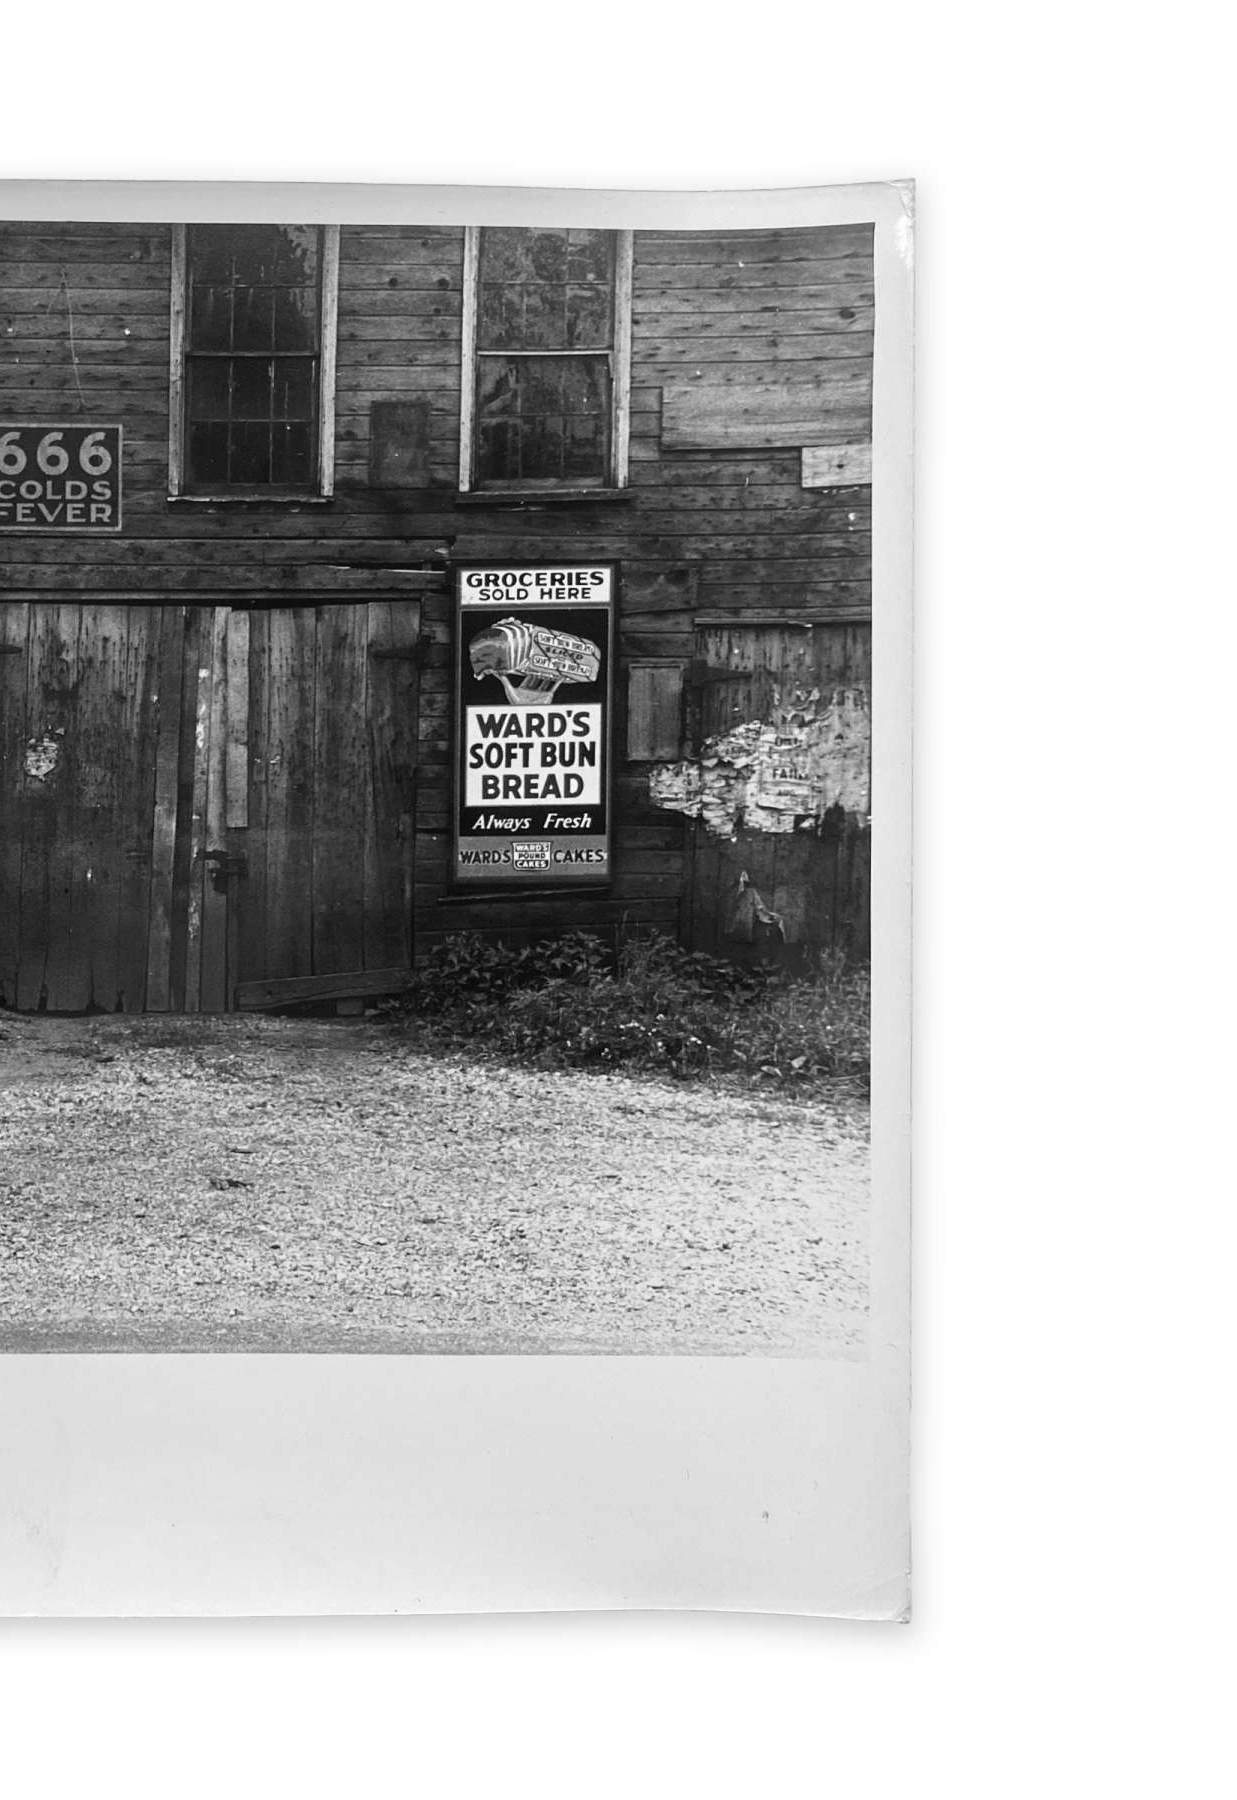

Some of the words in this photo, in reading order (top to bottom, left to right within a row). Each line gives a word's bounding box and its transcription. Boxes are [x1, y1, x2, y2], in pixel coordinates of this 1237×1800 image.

[466, 571, 604, 588] GROCERIES
[479, 588, 529, 601] SOLD
[540, 587, 592, 600] HERE
[476, 710, 590, 738] WARD'S
[469, 742, 534, 769] SOFT
[540, 741, 596, 768] BUN
[481, 773, 584, 800] BREAD
[472, 813, 532, 832] Always
[543, 812, 592, 829] Fresh
[516, 859, 547, 868] CAKES
[553, 849, 605, 863] CAKES
